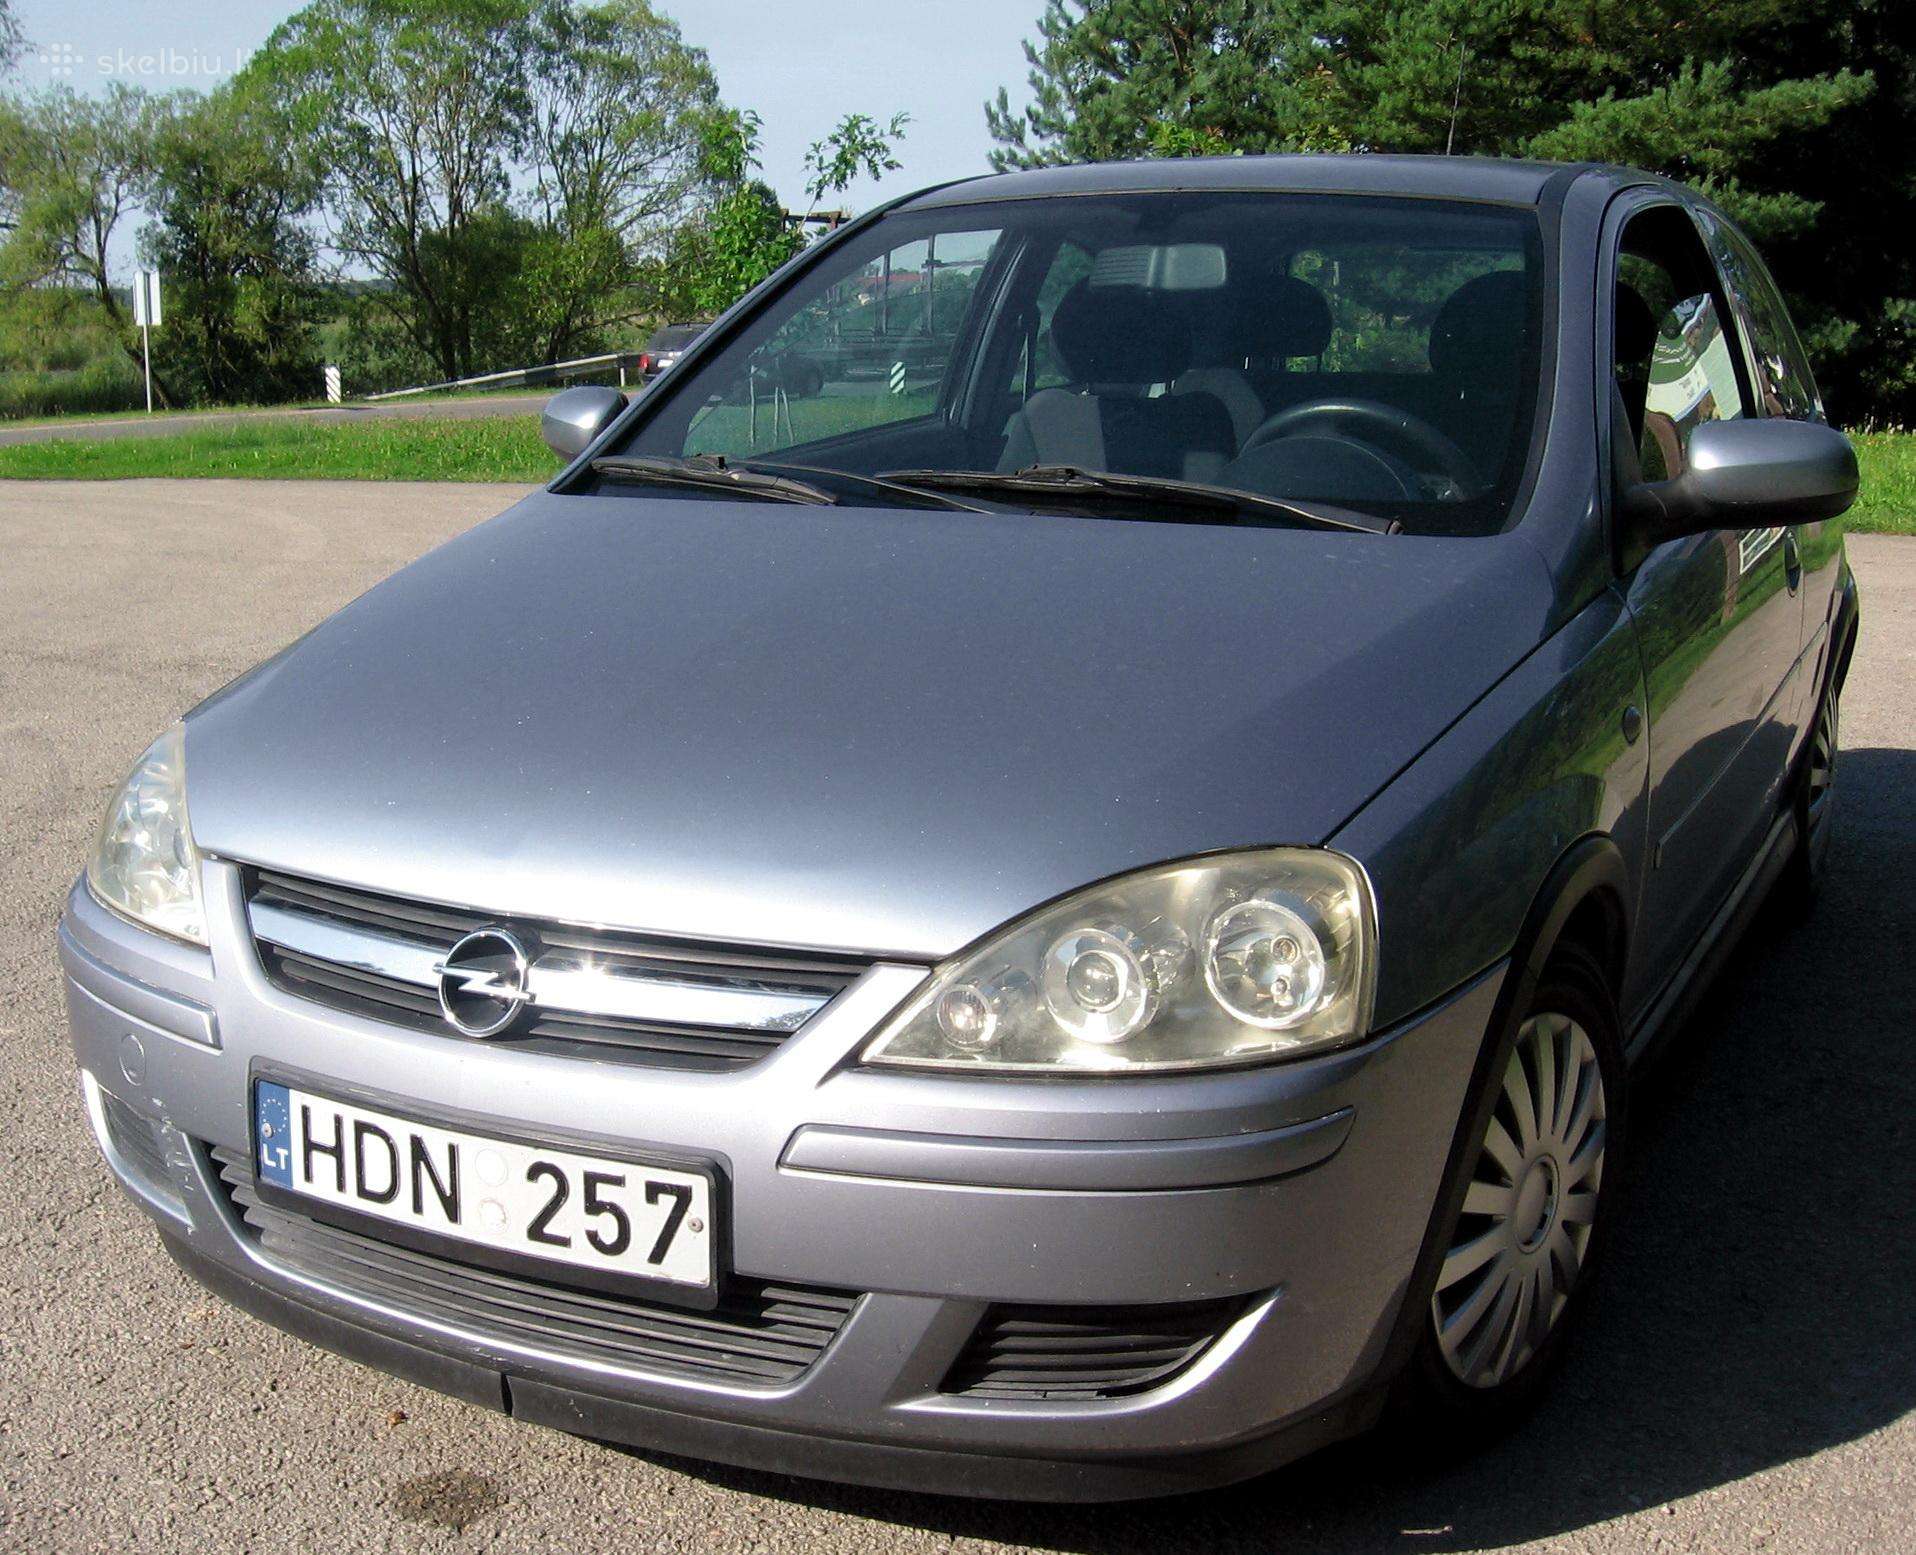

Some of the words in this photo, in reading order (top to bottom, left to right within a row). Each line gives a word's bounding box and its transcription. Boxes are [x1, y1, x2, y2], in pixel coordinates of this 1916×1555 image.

[262, 1143, 289, 1171] LT
[300, 1104, 462, 1225] HDN
[526, 1161, 693, 1265] 257
